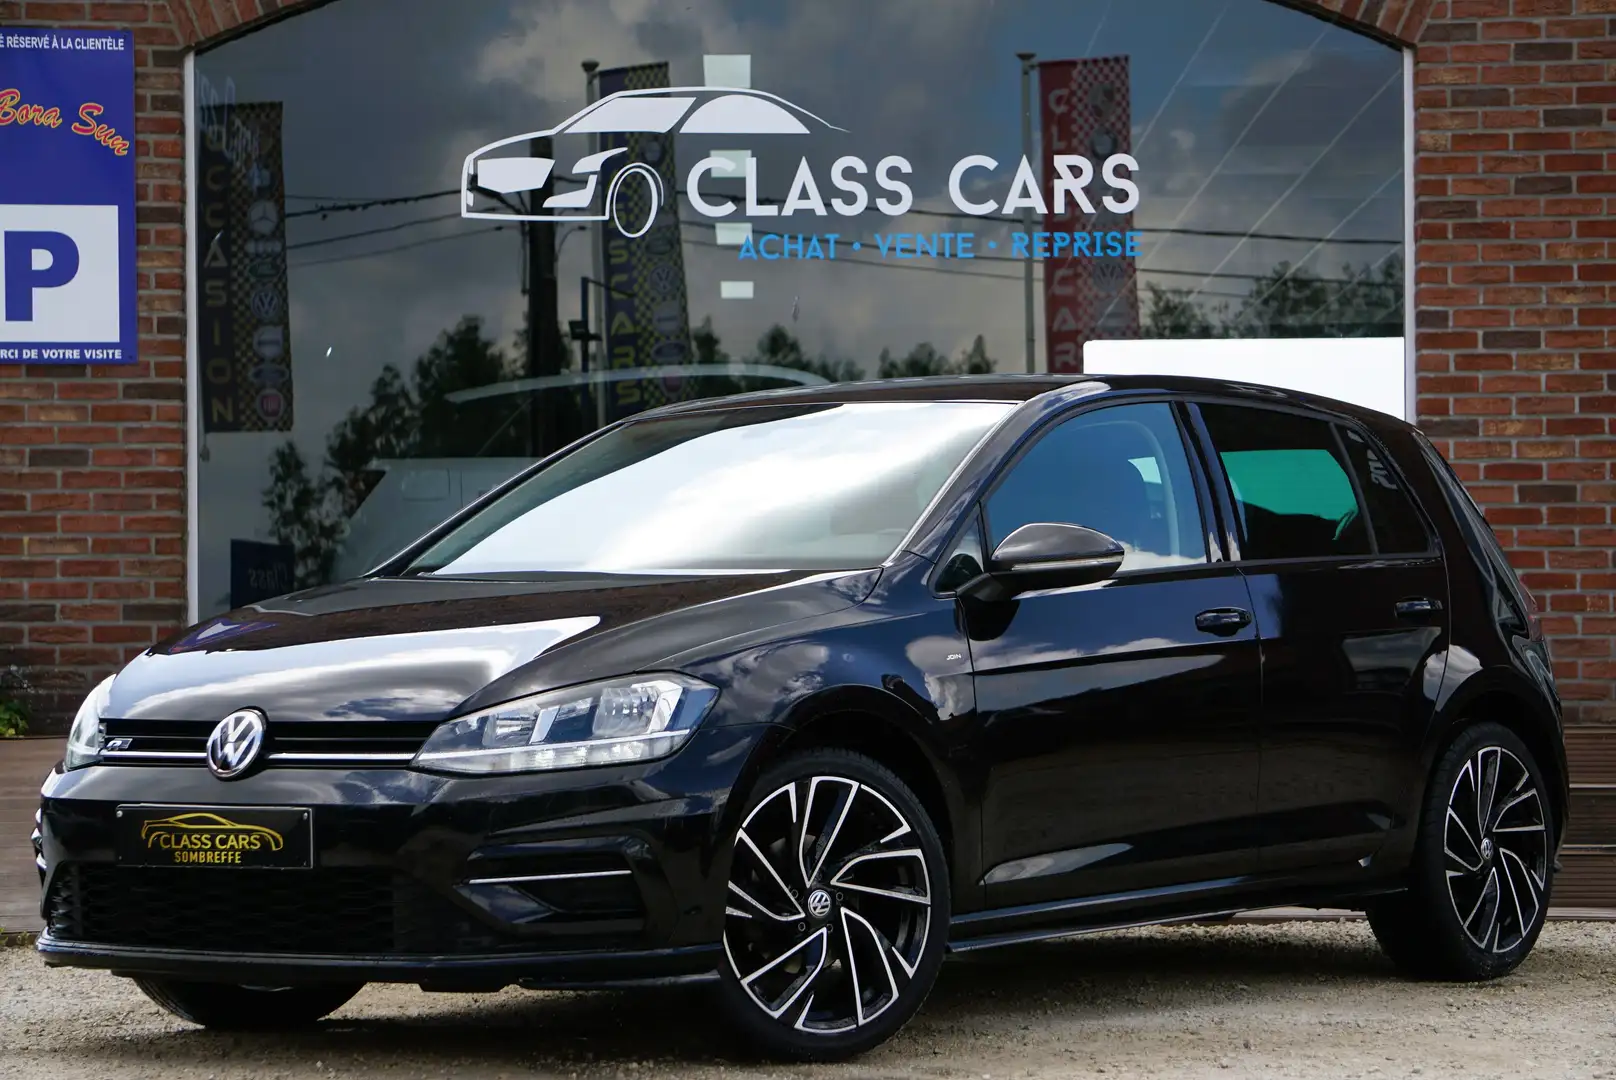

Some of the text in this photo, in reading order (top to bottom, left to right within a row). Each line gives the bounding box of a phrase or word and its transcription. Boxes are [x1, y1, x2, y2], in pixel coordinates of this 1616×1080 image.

[6, 33, 50, 49] RÉSERVÉ
[52, 34, 59, 49] À
[60, 37, 73, 50] LA
[74, 36, 125, 51] CLIENTÈLE
[0, 88, 130, 156] Bora Sun
[686, 154, 1140, 217] CLASS CARS
[738, 230, 1143, 260] ACHAT VENTE REPRISE
[4, 230, 80, 322] P
[22, 348, 38, 359] DE
[42, 348, 80, 359] VOTRE
[84, 348, 122, 360] VISITE
[160, 834, 261, 850] CLASS CARS
[174, 850, 242, 864] SOMBREFFE
